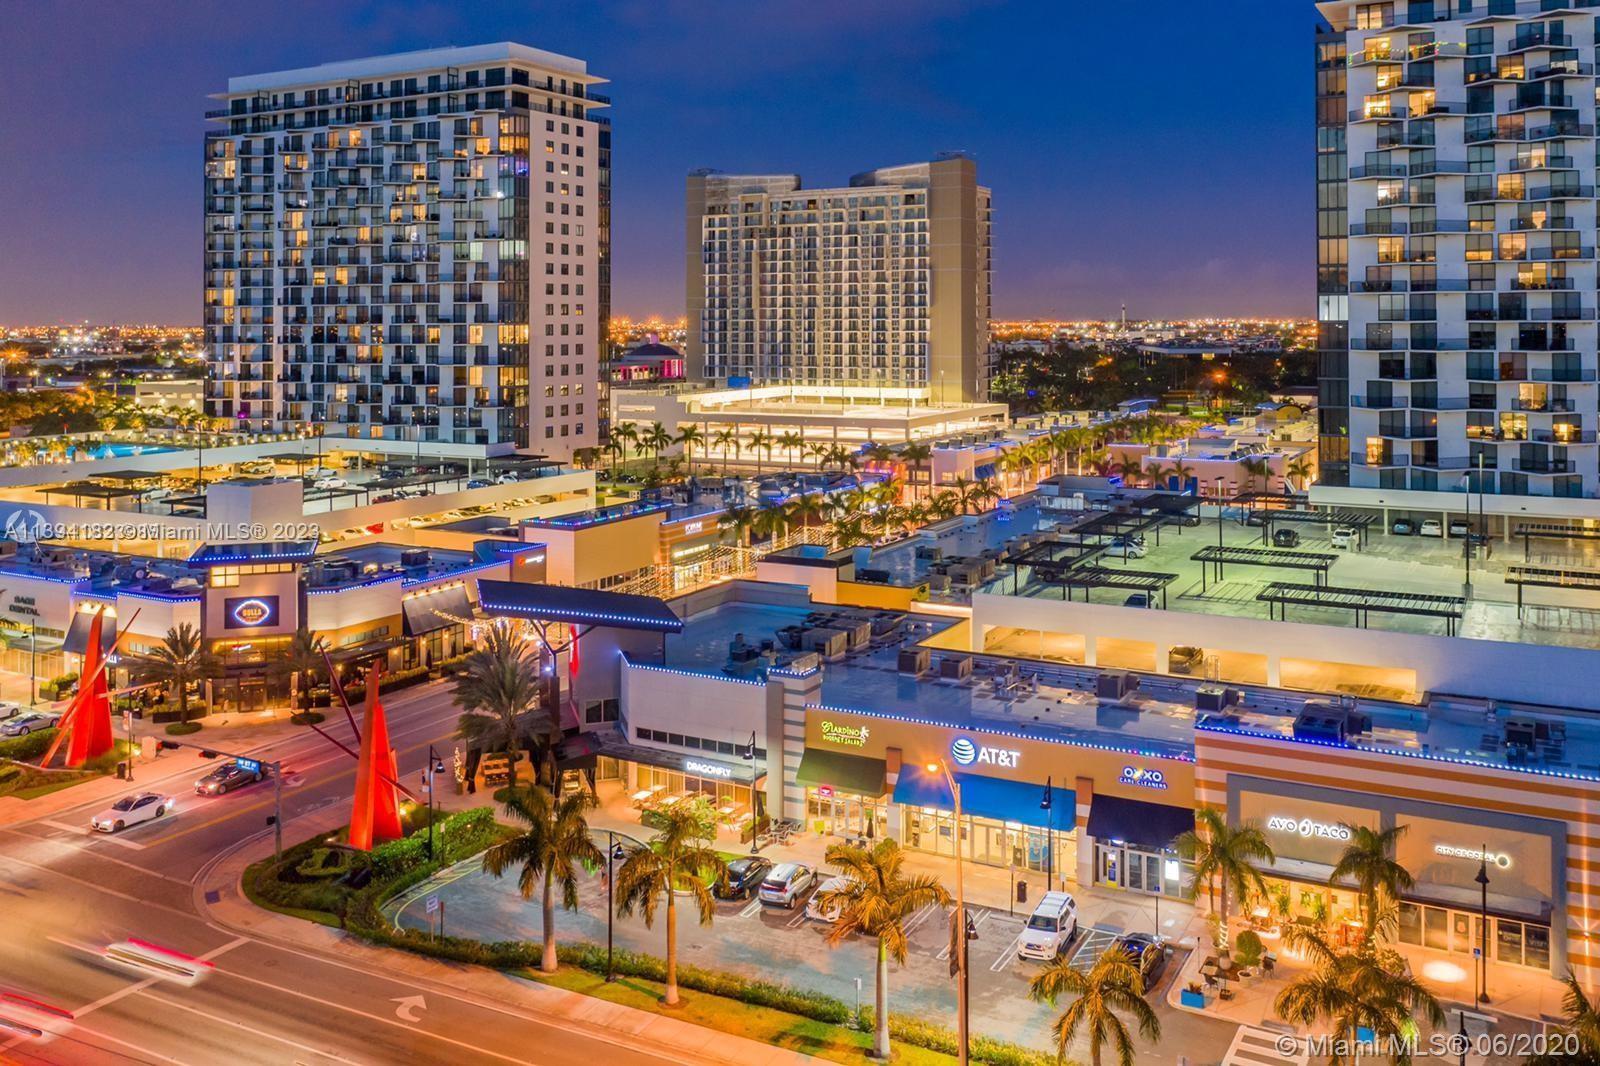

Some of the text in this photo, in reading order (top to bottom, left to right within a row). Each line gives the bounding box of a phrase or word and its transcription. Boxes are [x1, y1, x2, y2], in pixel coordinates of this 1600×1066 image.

[977, 746, 1021, 768] AT&T
[686, 761, 731, 776] DRAGONFLY
[1268, 817, 1350, 840] AVO TACO
